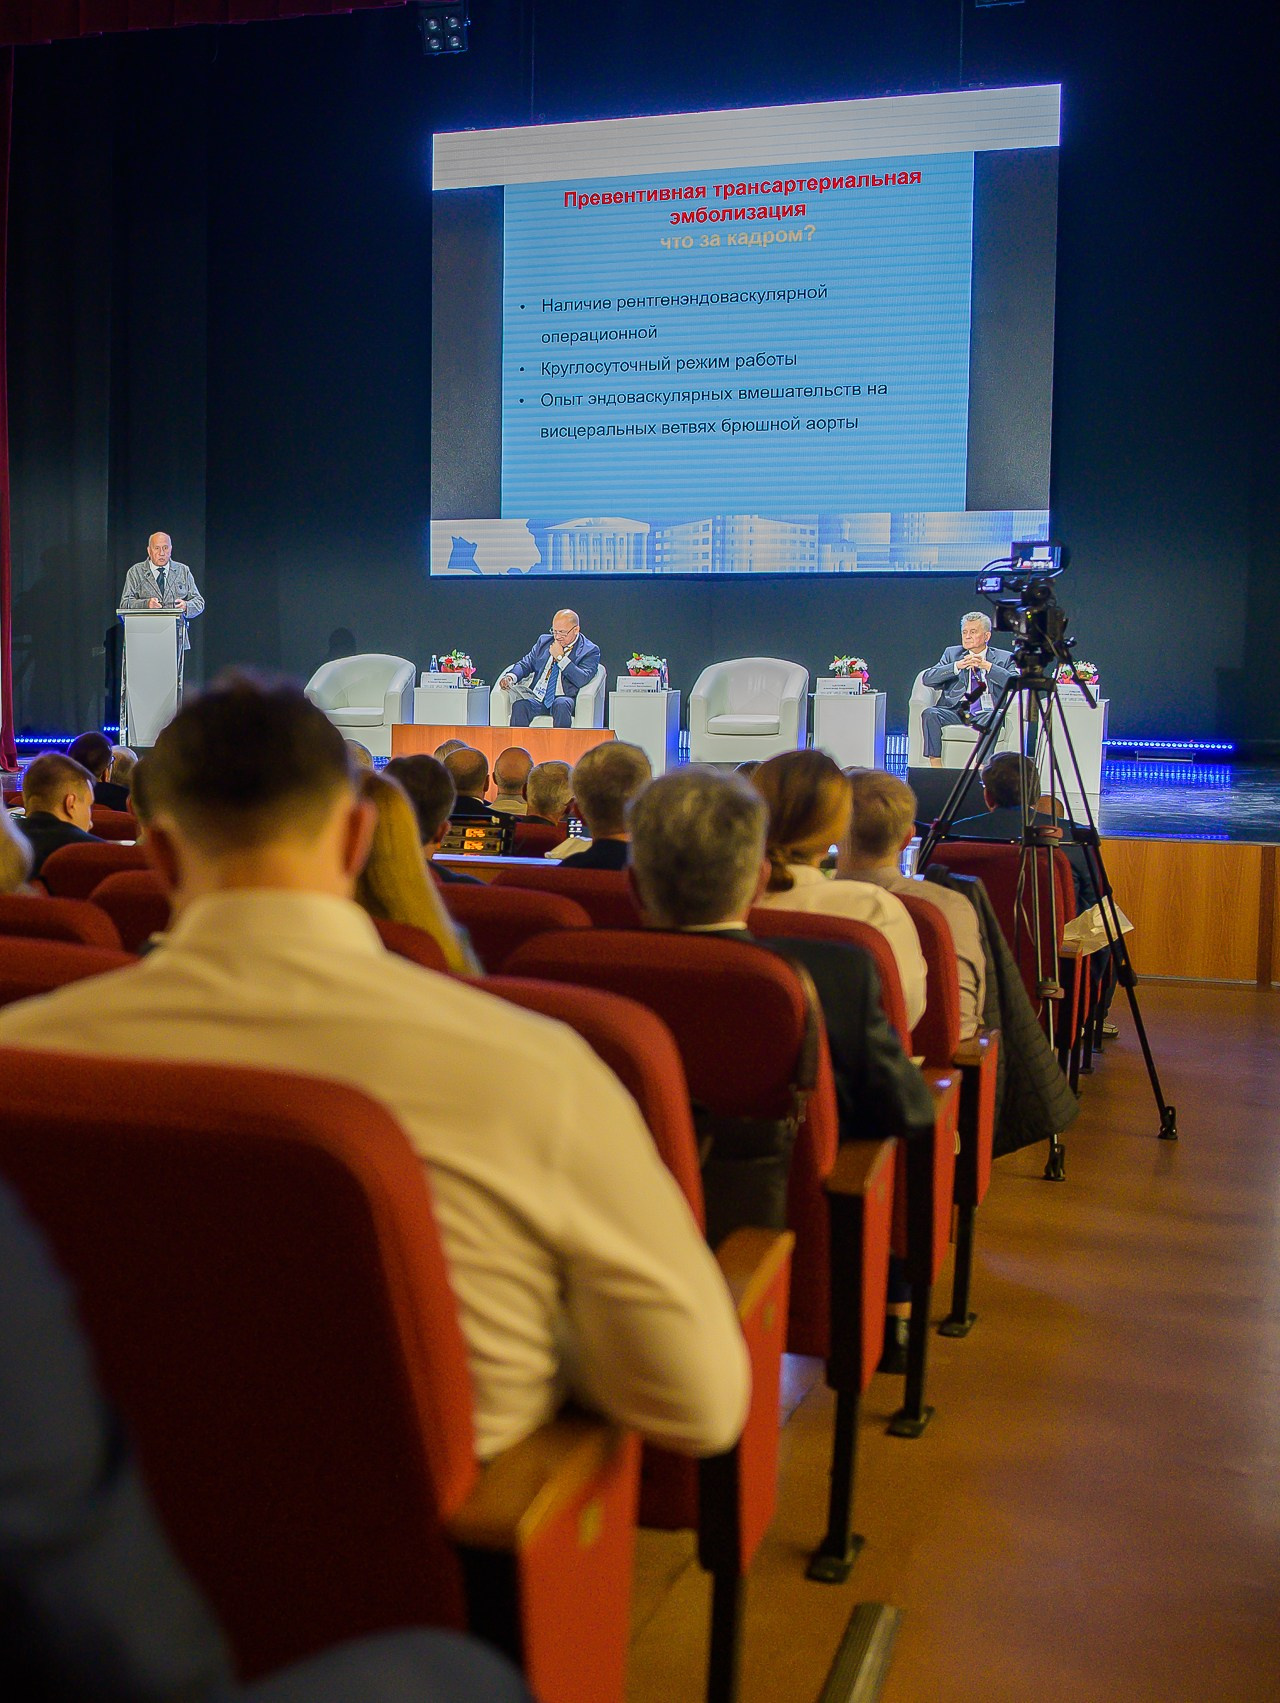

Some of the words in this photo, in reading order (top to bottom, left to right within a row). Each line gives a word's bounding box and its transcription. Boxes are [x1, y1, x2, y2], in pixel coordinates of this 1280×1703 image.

[564, 184, 706, 209] Превентивная
[713, 169, 922, 199] трансартериальная
[669, 202, 806, 225] эмболизация
[660, 234, 693, 250] что
[699, 233, 721, 248] за
[727, 224, 816, 248] кадром?
[542, 297, 612, 313] Наличие
[617, 284, 828, 311] рентгенэндоваскулярной
[541, 325, 657, 346] операционной
[541, 356, 671, 377] Круглосуточный
[676, 355, 730, 371] режим
[735, 352, 797, 368] работы
[541, 393, 583, 410] Опыт
[588, 387, 733, 406] эндоваскулярных
[738, 383, 861, 400] вмешательств
[867, 383, 888, 396] на
[540, 422, 656, 439] висцеральных
[661, 418, 716, 434] ветвях
[721, 415, 800, 433] брюшной
[806, 415, 858, 431] аорты
